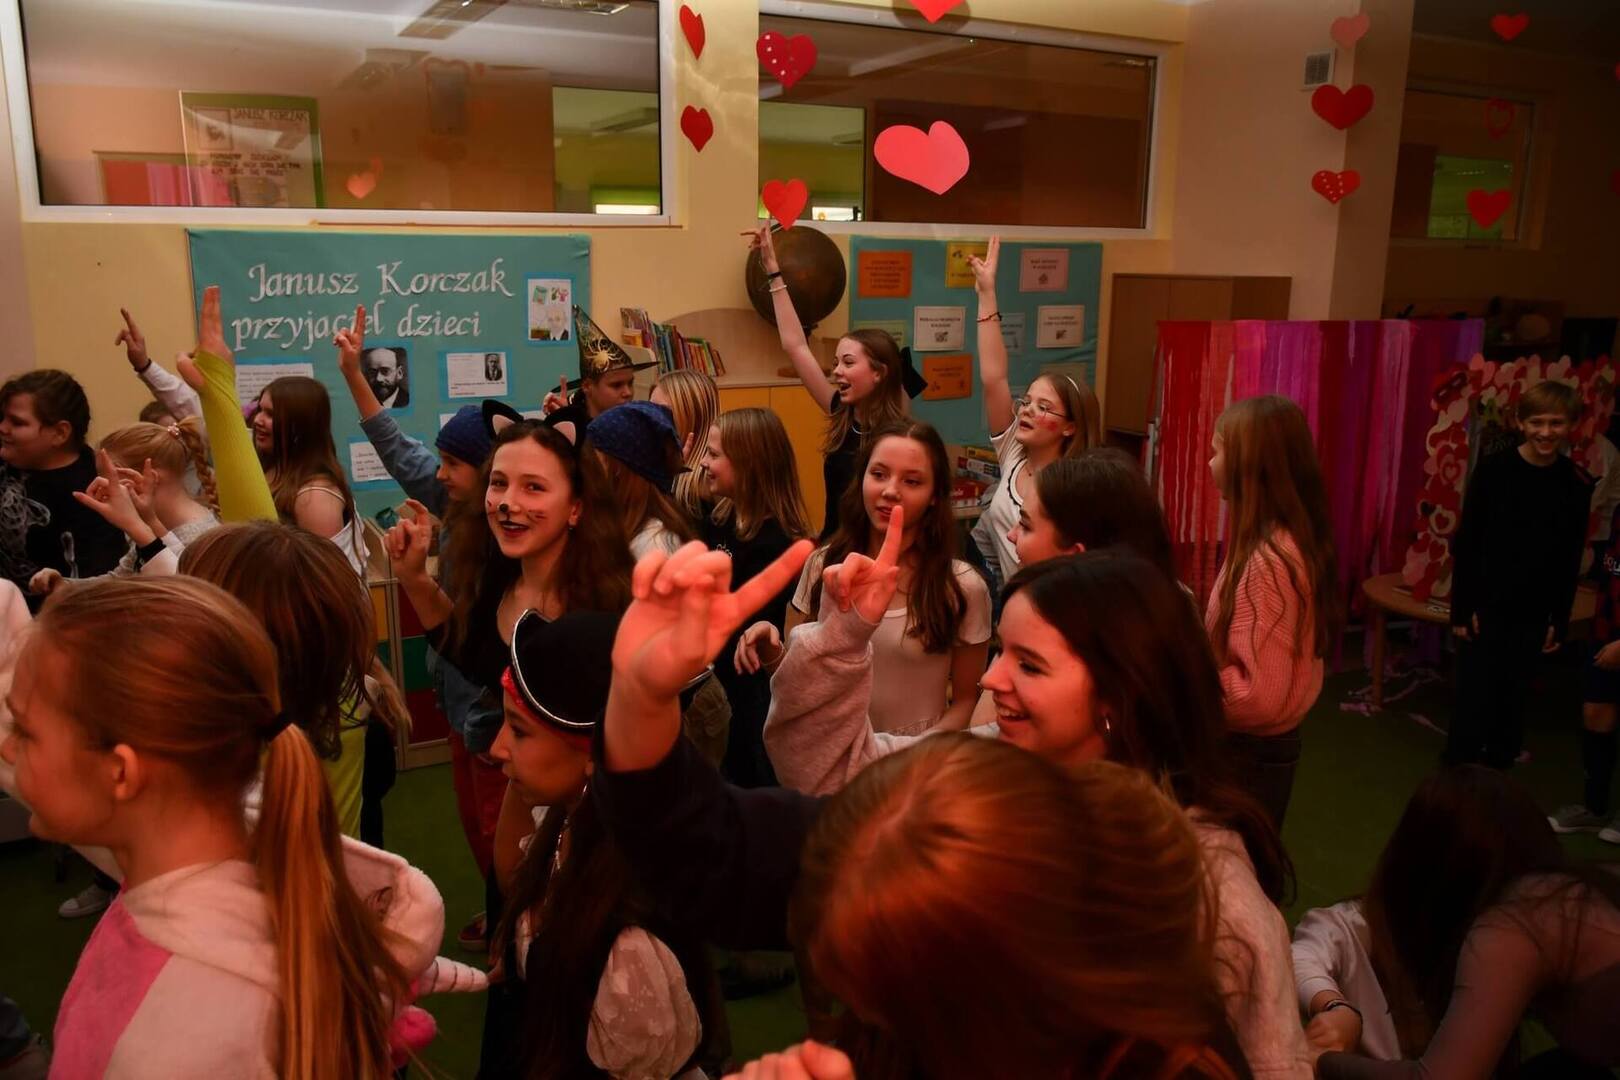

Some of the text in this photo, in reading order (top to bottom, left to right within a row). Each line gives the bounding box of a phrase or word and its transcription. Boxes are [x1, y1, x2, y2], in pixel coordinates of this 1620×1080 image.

[248, 258, 514, 302] Janusz Korczak
[396, 303, 481, 337] dzieci
